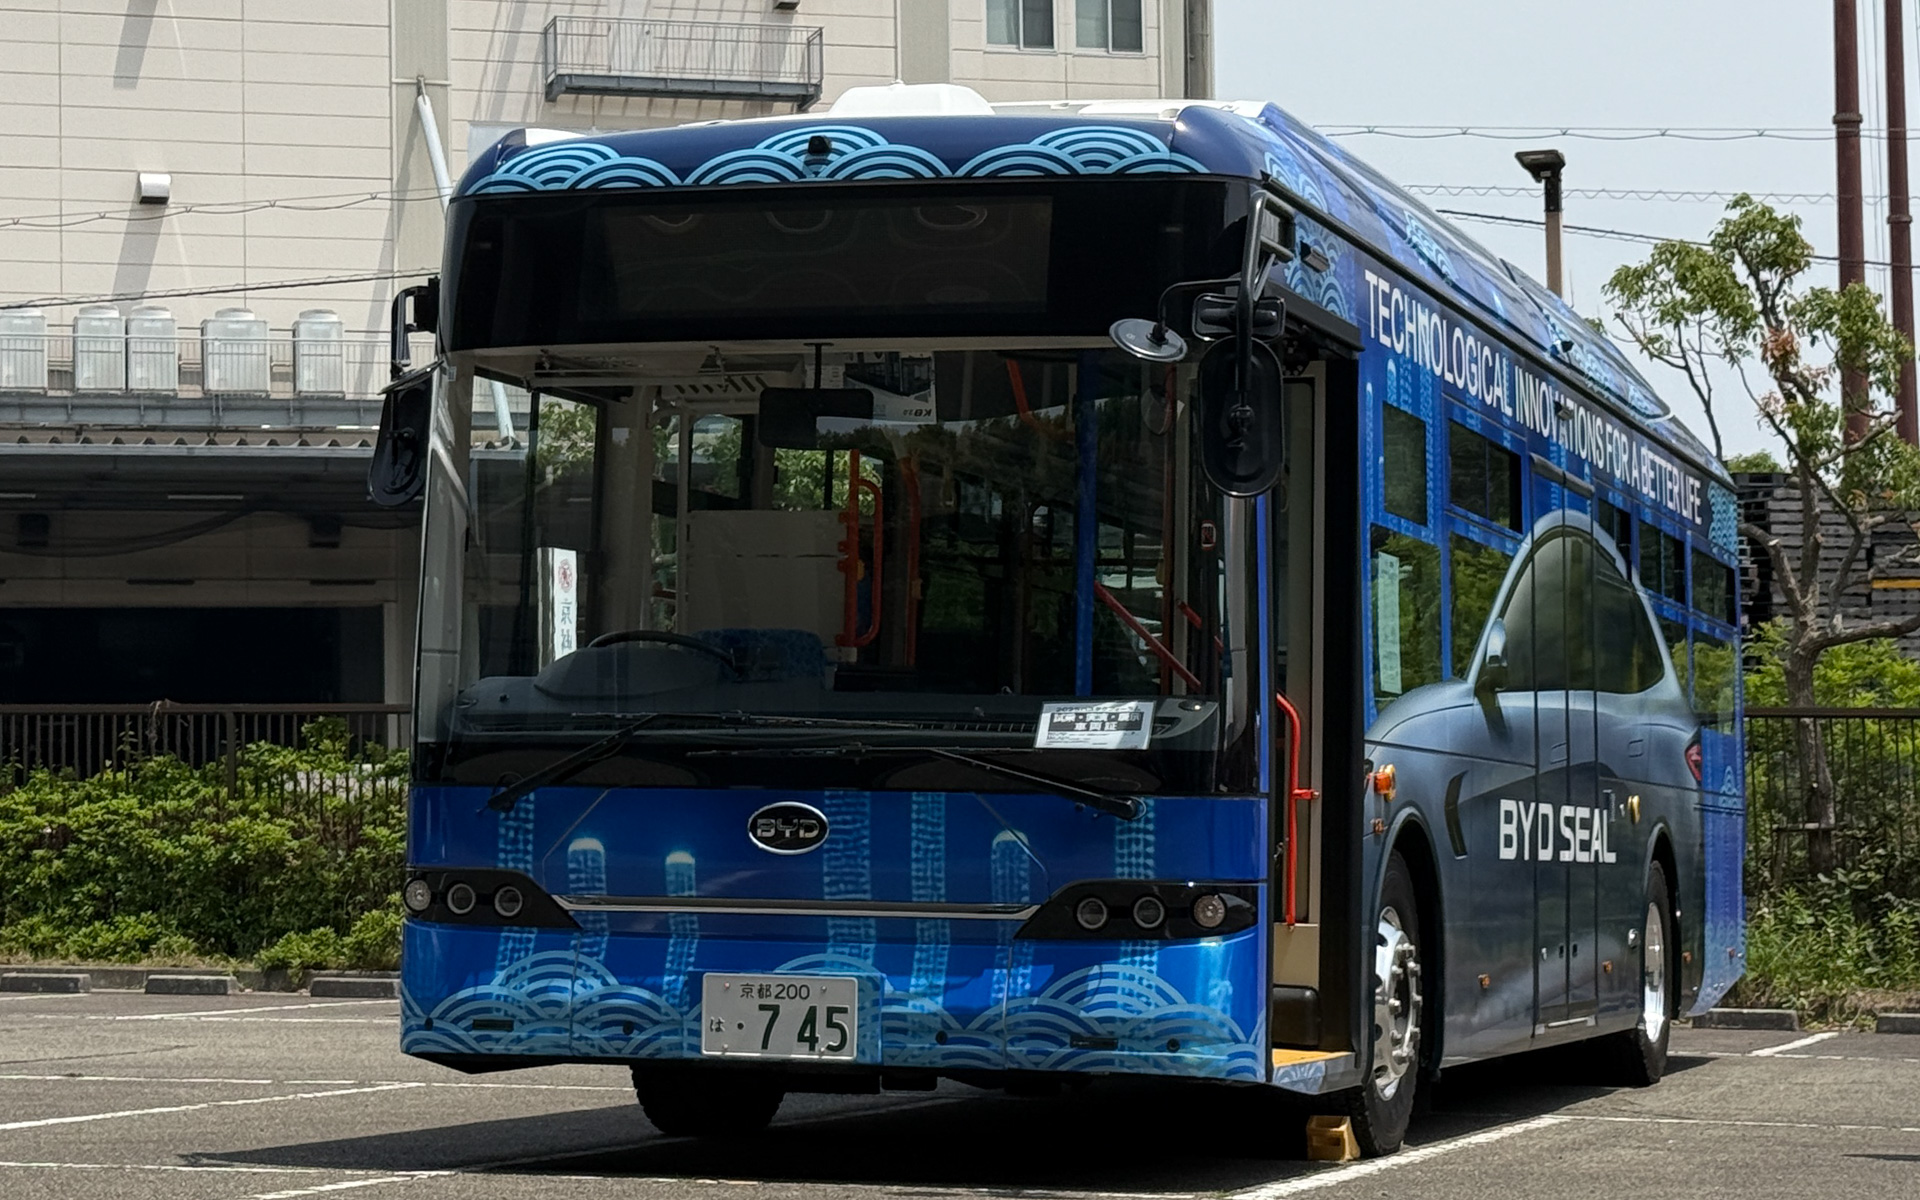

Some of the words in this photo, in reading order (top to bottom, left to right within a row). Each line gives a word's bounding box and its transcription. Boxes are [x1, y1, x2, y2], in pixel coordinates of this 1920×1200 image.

[1365, 269, 1513, 417] TECHNOLOGICAL
[1515, 365, 1605, 470] INNOVATIONS
[1605, 422, 1630, 485] FOR
[1631, 441, 1641, 491] A
[1641, 446, 1680, 514] BETTER
[1680, 471, 1702, 525] LIFE
[757, 818, 820, 839] BYD
[1499, 799, 1554, 861] BYD
[1559, 805, 1617, 863] SEAL
